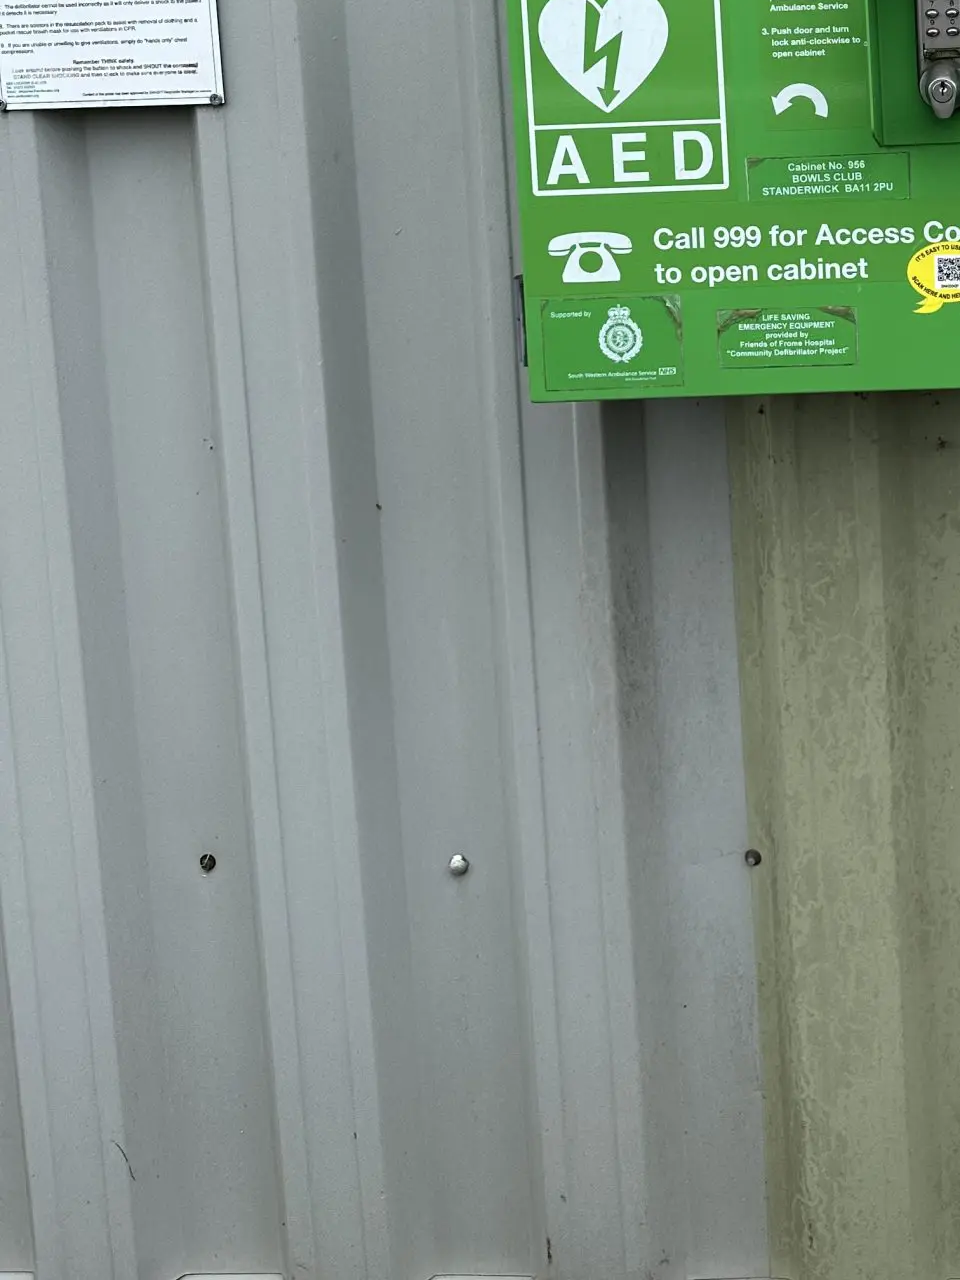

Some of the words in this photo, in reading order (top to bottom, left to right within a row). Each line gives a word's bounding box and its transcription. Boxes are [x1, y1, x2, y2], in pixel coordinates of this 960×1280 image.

[770, 3, 816, 12] Ambulance
[818, 2, 848, 10] Service
[771, 27, 791, 35] Push
[794, 26, 813, 34] door
[832, 25, 849, 33] turn
[772, 38, 789, 46] lock
[791, 37, 850, 45] anti-clockwise
[772, 50, 793, 58] open
[795, 48, 825, 56] cabinet
[788, 162, 826, 171] Cabinet
[828, 161, 845, 170] No.
[848, 160, 865, 169] 956
[792, 173, 830, 183] BOWLS
[833, 172, 863, 181] CLUB
[762, 185, 839, 196] STANDERWICK
[845, 183, 870, 192] BA11
[873, 183, 893, 192] 2PU
[653, 228, 706, 251] Call
[713, 226, 763, 249] 999
[769, 224, 808, 247] for
[815, 222, 915, 246] Access
[915, 253, 926, 263] IT'S
[925, 245, 941, 256] EASY
[654, 265, 682, 285] to
[690, 264, 751, 288] open
[761, 257, 868, 281] cabinet
[912, 275, 924, 289] SCAN
[924, 286, 938, 298] HERE
[550, 311, 582, 319] Supported
[738, 322, 787, 331] EMERGENCY
[789, 321, 835, 330] EQUIPMENT
[765, 331, 798, 340] provided
[800, 331, 809, 340] by
[740, 340, 767, 348] Friends
[779, 339, 803, 347] Frome
[805, 339, 835, 348] Hospital
[774, 348, 817, 356] Defibrillator
